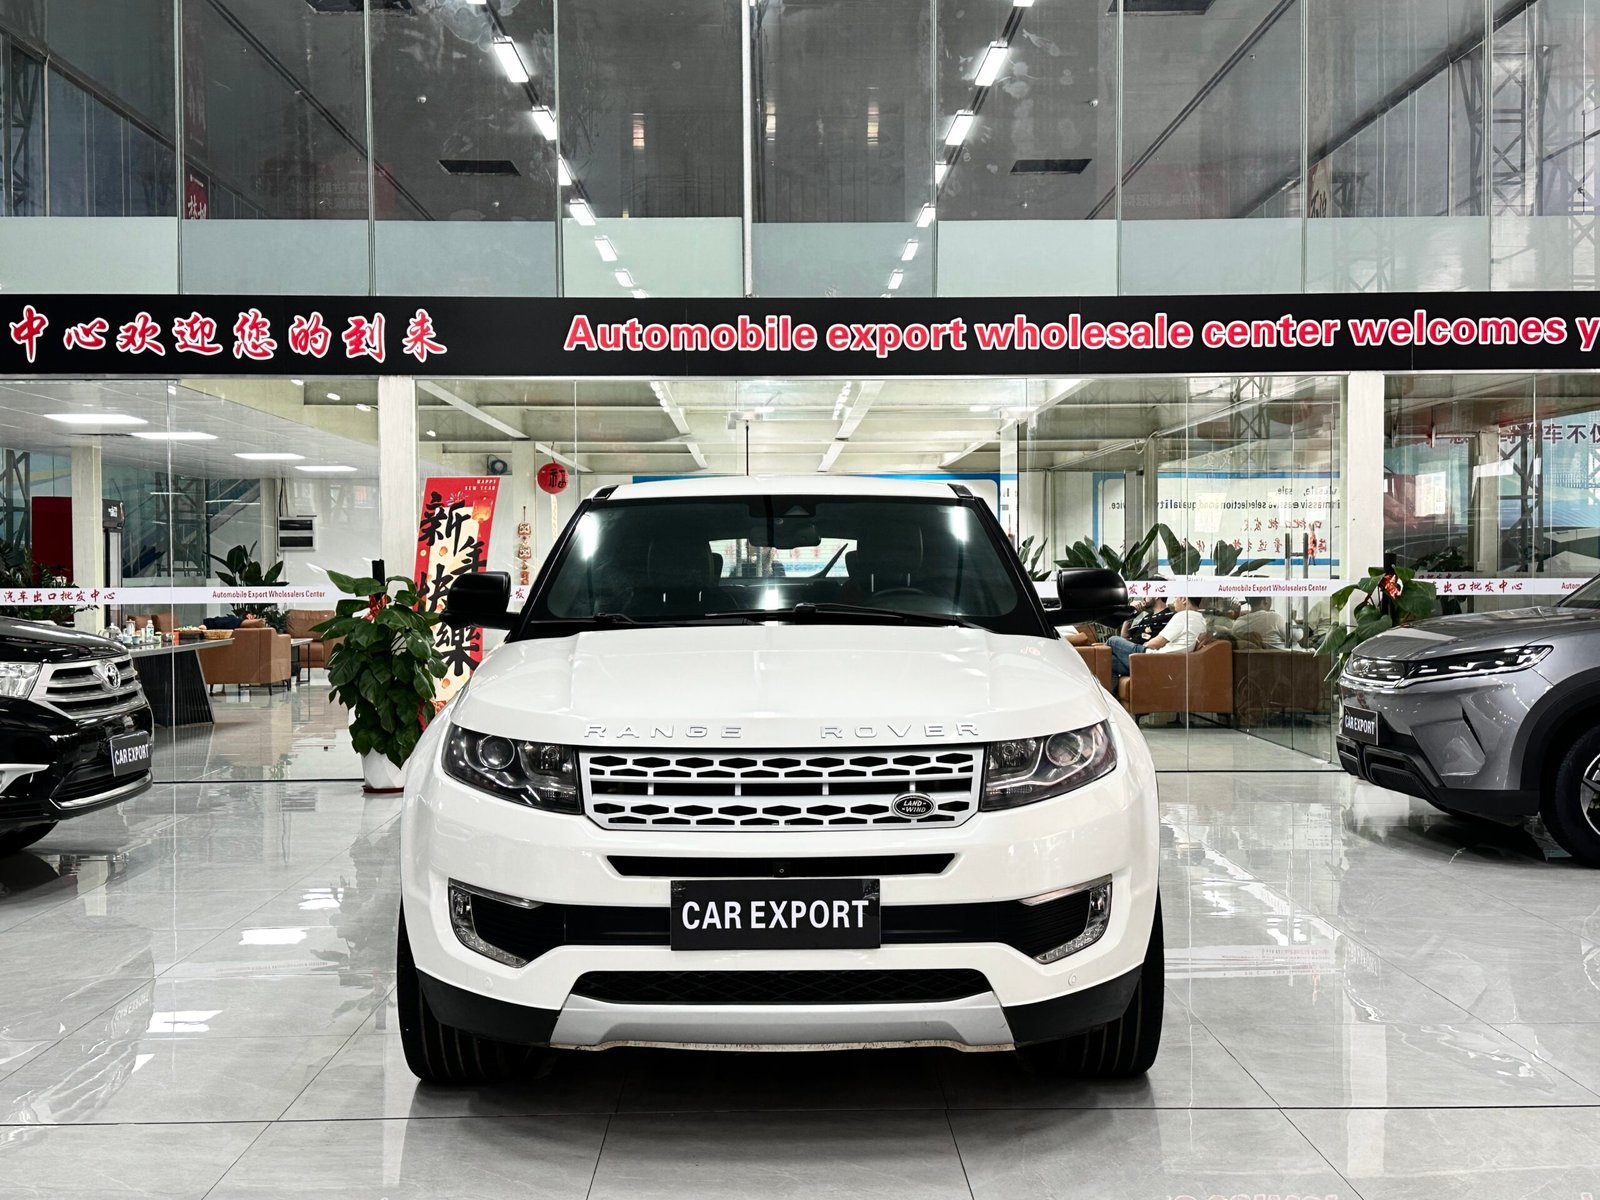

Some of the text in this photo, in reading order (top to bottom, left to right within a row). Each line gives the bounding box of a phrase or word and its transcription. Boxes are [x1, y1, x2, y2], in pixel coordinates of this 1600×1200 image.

[10, 305, 447, 363] 中心欢迎您的到来
[563, 313, 818, 352] Automobile
[826, 316, 967, 358] export
[974, 312, 1194, 351] wholesale
[1201, 313, 1341, 349] center
[1348, 309, 1568, 346] welcomes
[4, 589, 116, 603] 汽车出口批发中心
[213, 590, 247, 598] Automobile
[248, 590, 267, 599] Export
[305, 589, 326, 598] Center
[1218, 584, 1251, 592] Automobile
[1252, 584, 1271, 593] Export
[1308, 583, 1328, 592] Center
[1435, 580, 1523, 594] 出口批发中心
[583, 721, 981, 740] RANGE ROVER
[1354, 717, 1375, 735] EXPORT
[114, 744, 149, 765] CAR EXPORT
[681, 900, 869, 930] CAR EXPORT
